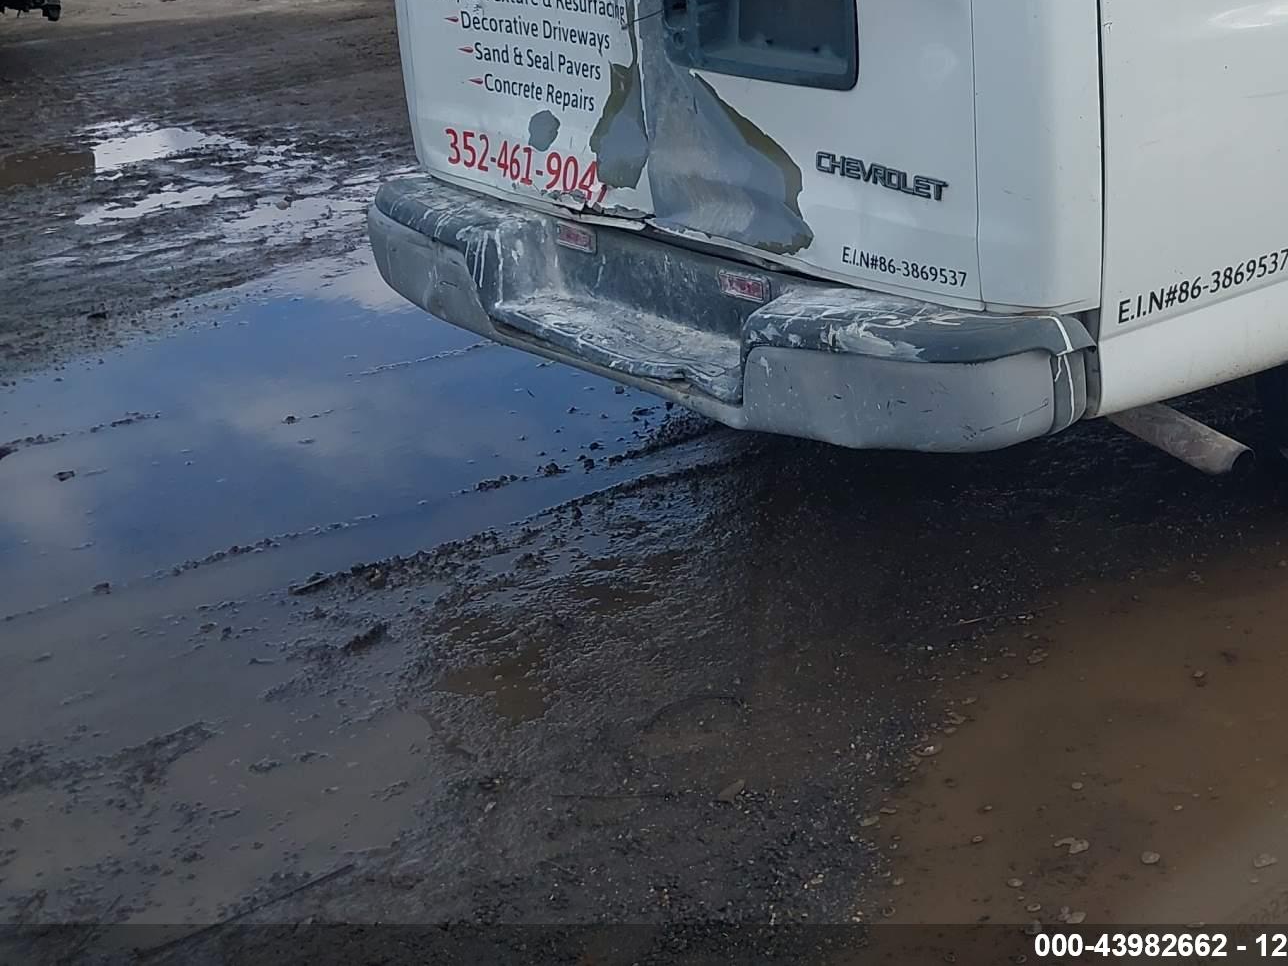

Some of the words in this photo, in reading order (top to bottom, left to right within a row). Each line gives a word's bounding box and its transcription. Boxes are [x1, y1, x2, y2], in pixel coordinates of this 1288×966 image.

[461, 10, 538, 38] Decorative
[543, 20, 610, 56] Driveways
[474, 42, 509, 65] Sand
[513, 46, 523, 66] &
[527, 47, 554, 72] Seal
[559, 54, 601, 81] Pavers
[485, 74, 542, 102] Concrete
[546, 83, 595, 113] Repairs
[815, 151, 949, 202] CHEVROLET
[842, 246, 967, 289] E.I.N#86-3869537
